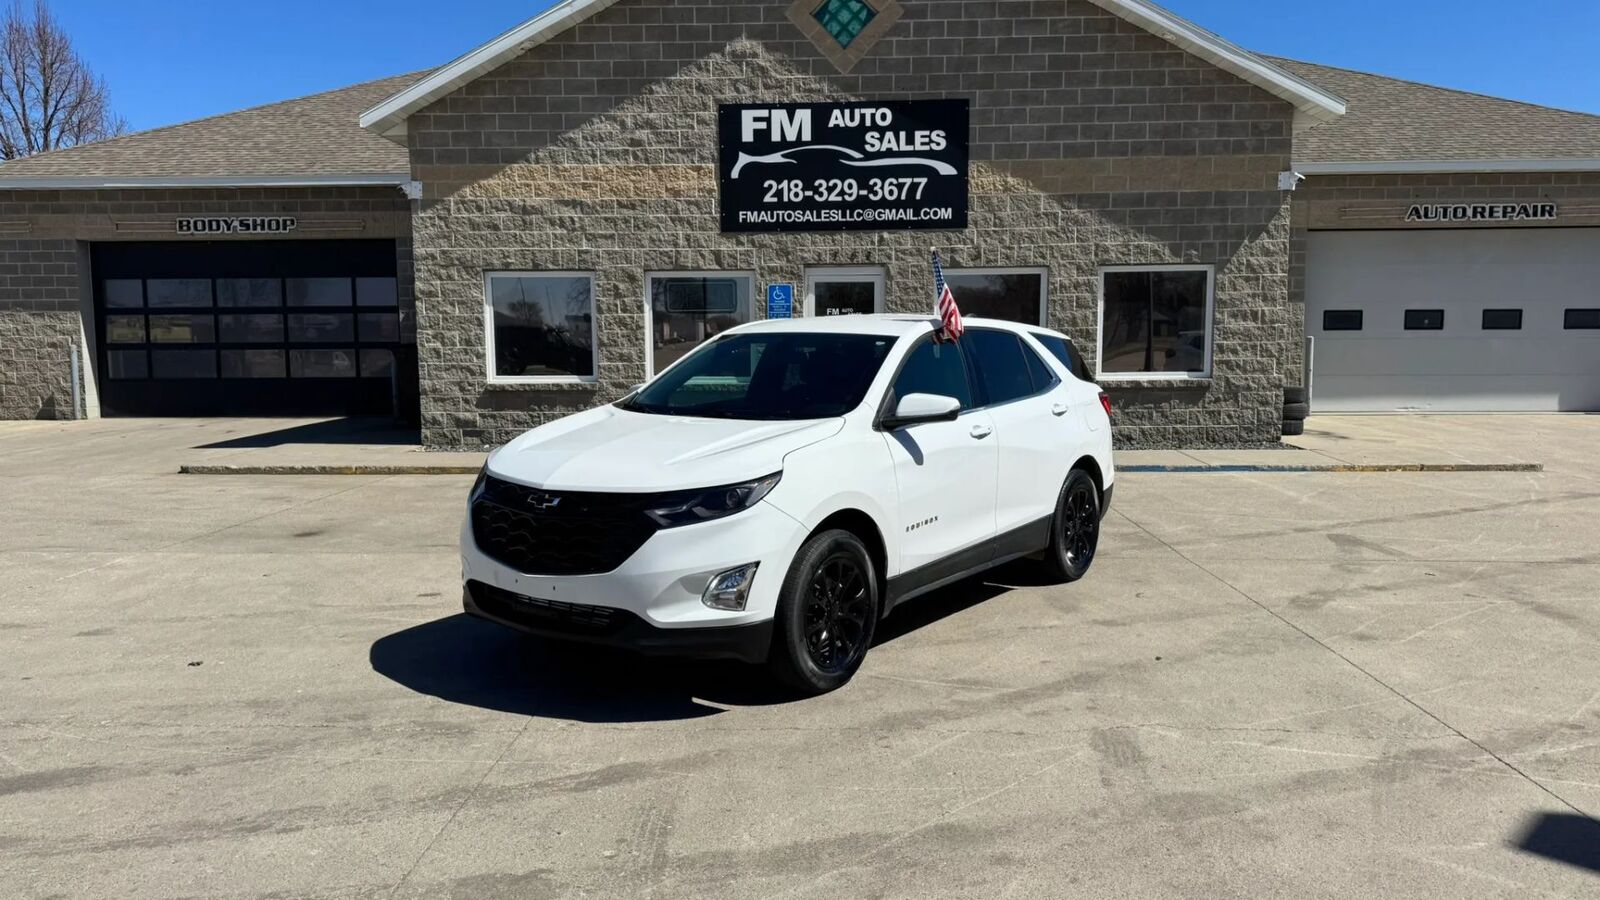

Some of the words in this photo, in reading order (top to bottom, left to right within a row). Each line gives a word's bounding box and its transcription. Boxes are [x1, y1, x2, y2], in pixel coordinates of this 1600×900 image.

[741, 109, 812, 142] FM
[828, 108, 893, 128] AUTO
[864, 130, 947, 152] SALES
[763, 178, 928, 203] 218-329-3677
[739, 208, 953, 223] FMAUTOSALESLLC@GMAIL.COM
[1405, 204, 1469, 222] AUTO
[1470, 203, 1557, 221] REPAIR
[176, 217, 236, 234] BODY
[237, 216, 297, 233] SHOP
[826, 307, 840, 316] FM
